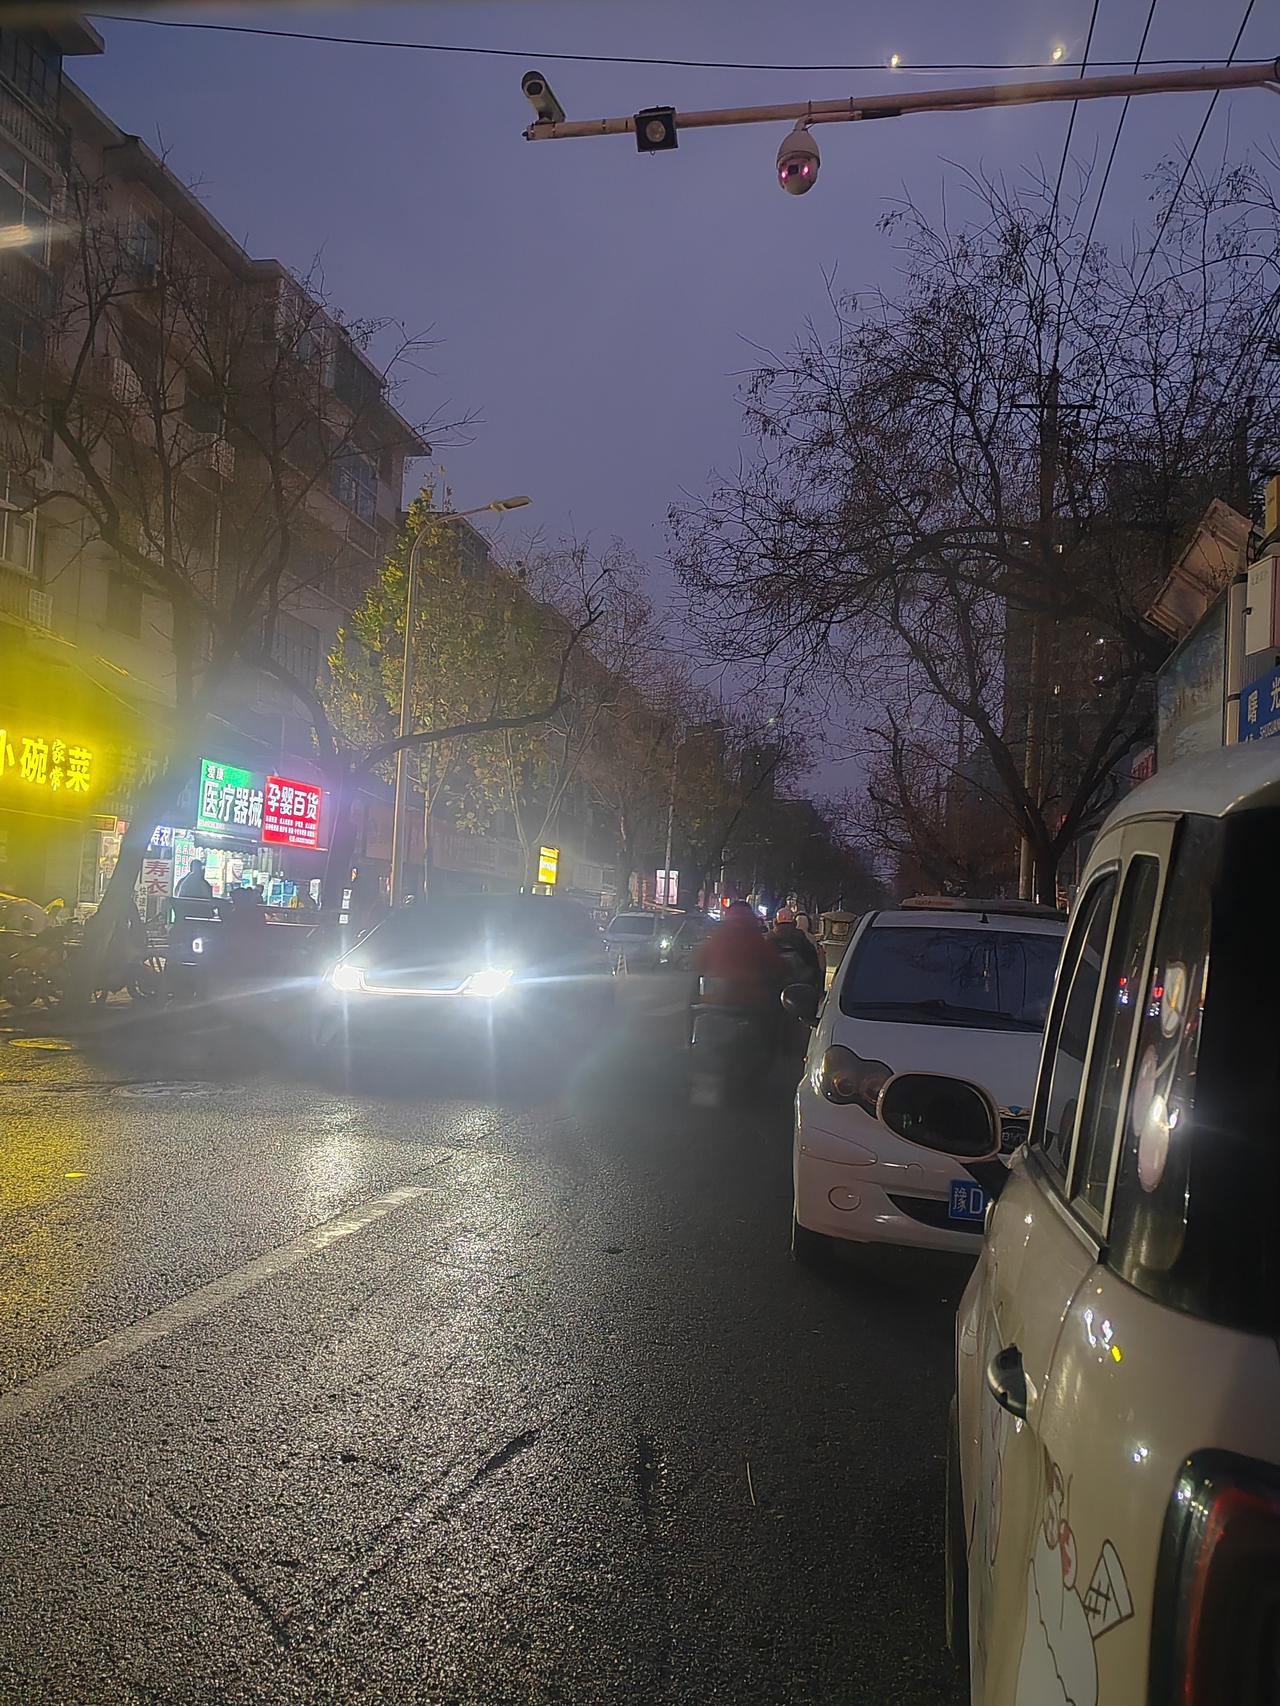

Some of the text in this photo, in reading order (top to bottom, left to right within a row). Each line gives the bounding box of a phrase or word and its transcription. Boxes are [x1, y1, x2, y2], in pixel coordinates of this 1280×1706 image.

[202, 779, 264, 829] 医疗器械
[267, 783, 319, 820] 孕婴百货
[145, 861, 170, 895] 寿衣
[953, 1186, 984, 1215] 豫D
